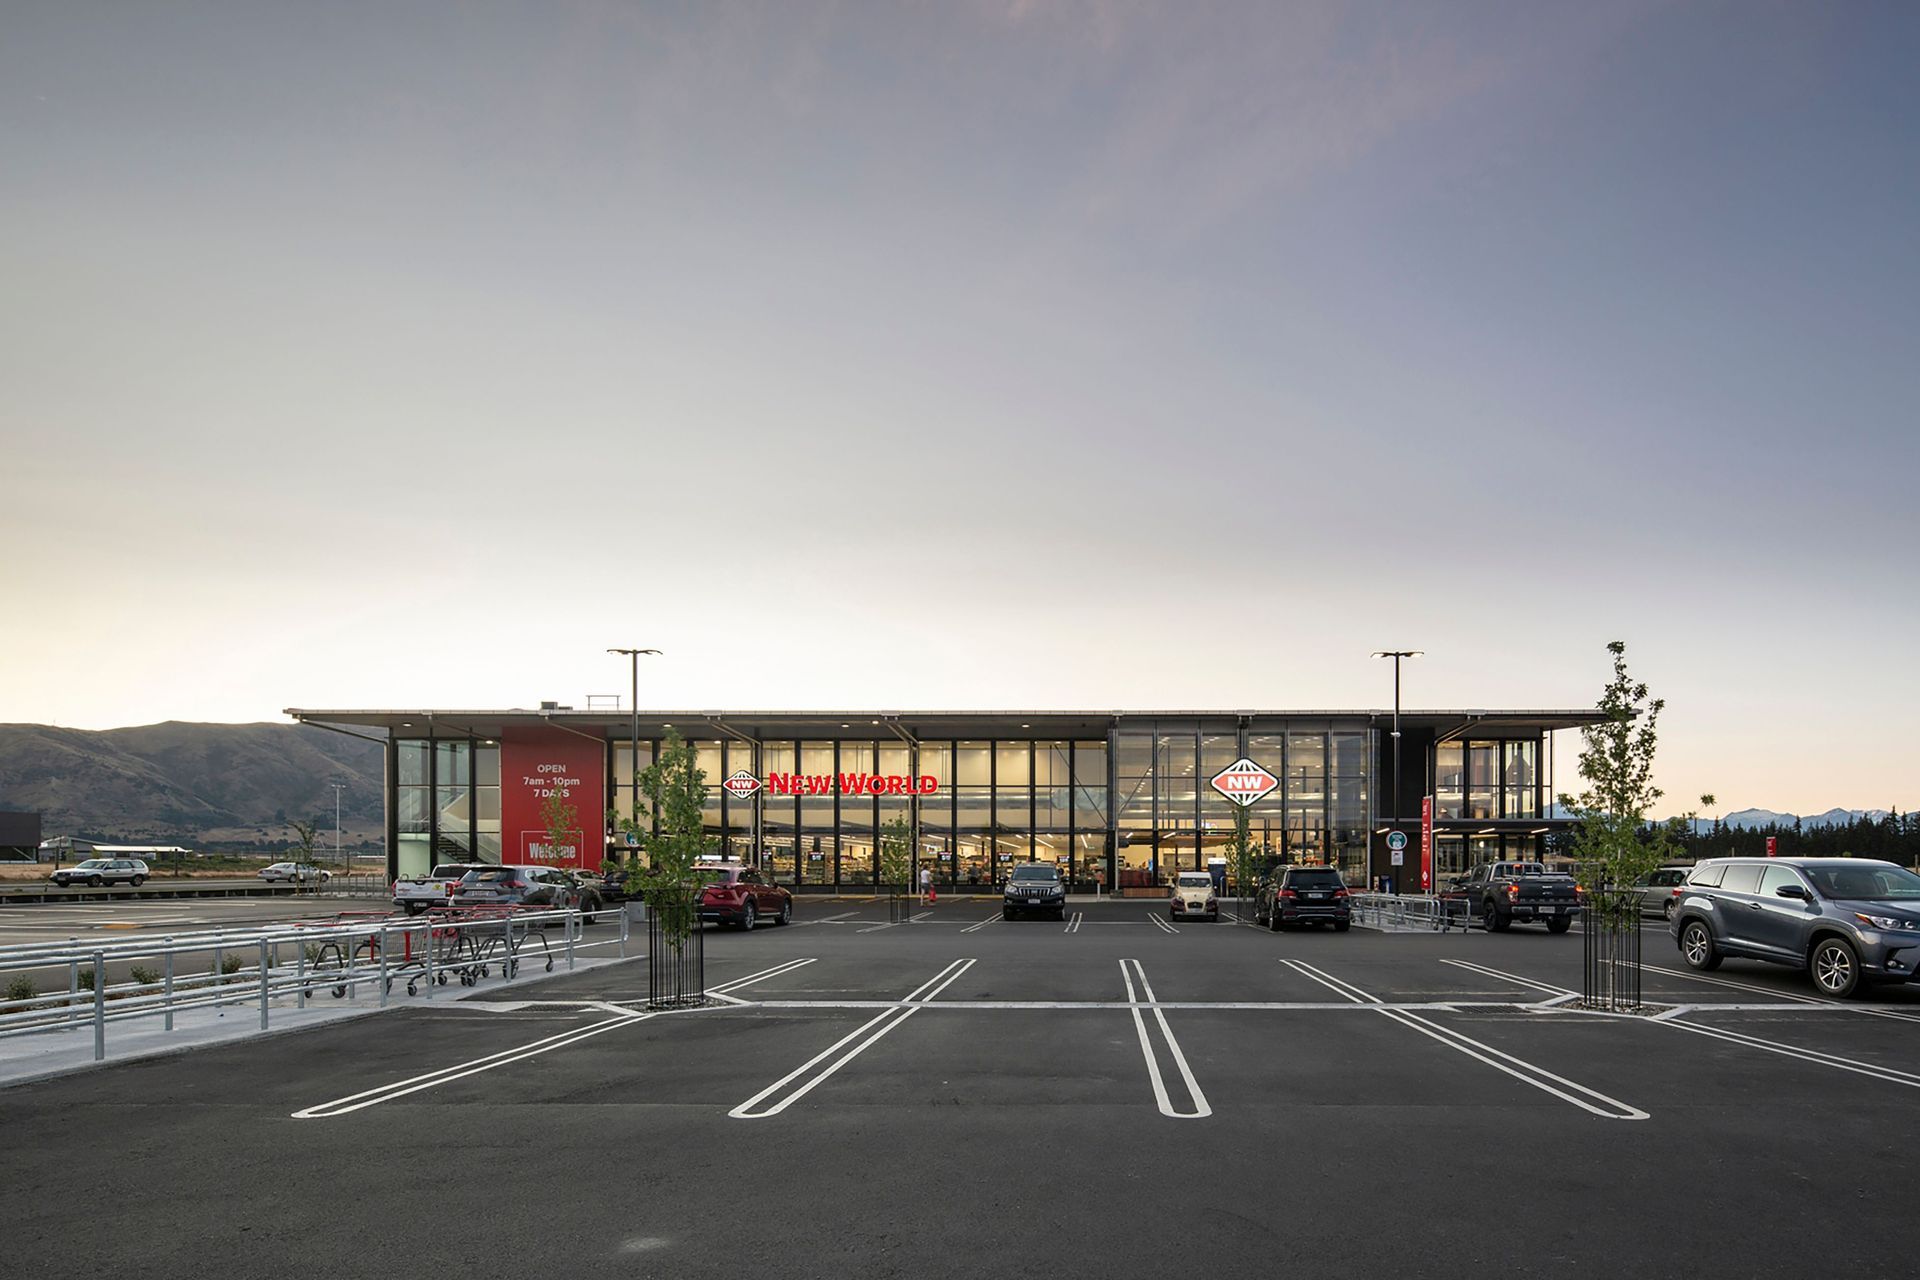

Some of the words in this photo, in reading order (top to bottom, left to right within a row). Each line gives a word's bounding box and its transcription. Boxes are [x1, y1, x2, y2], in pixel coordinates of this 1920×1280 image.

[537, 764, 566, 773] OPEN
[523, 777, 544, 785] 7am
[553, 777, 580, 787] 10pm
[731, 780, 754, 789] NW
[769, 772, 832, 795] NEW
[839, 772, 938, 796] WORLD
[1227, 776, 1263, 789] NW
[534, 789, 539, 798] 7
